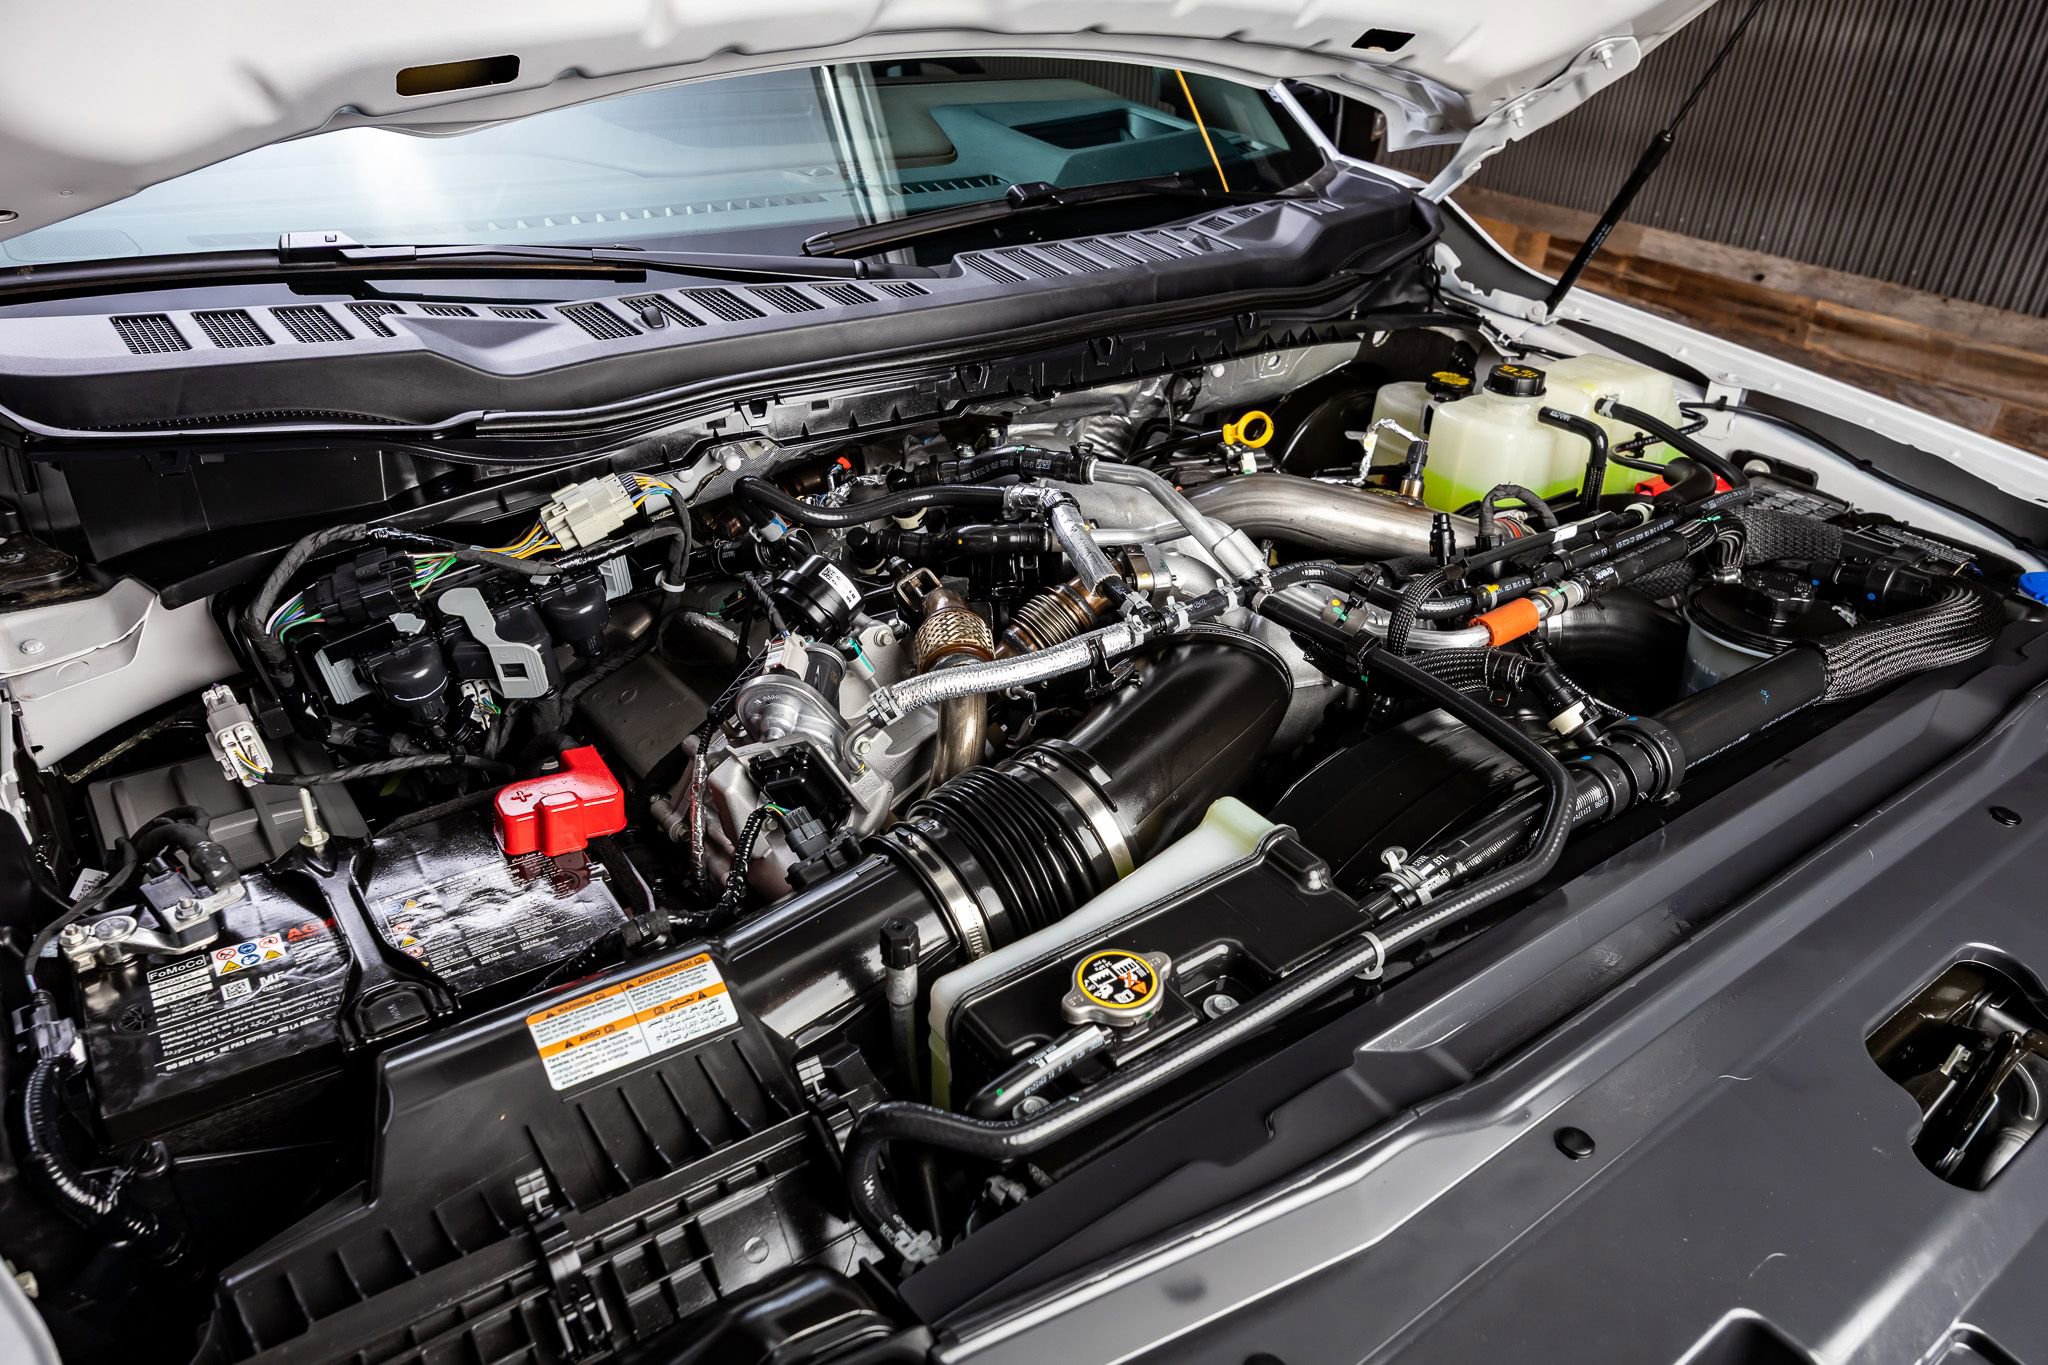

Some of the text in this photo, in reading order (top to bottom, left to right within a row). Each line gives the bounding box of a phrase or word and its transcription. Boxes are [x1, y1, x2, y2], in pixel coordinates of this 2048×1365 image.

[1432, 853, 1450, 866] BTL
[149, 959, 204, 982] FoMoCo
[259, 970, 286, 986] MF
[638, 961, 692, 984] AVERTISSEMENT
[170, 977, 206, 991] CCA/SAE
[558, 998, 592, 1012] WARNING
[669, 994, 694, 1011] تحذير
[166, 1062, 178, 1071] DO
[178, 1057, 193, 1067] NOT
[194, 1050, 216, 1062] OPEN.
[219, 1045, 229, 1053] NE
[230, 1039, 245, 1049] PAS
[245, 1030, 275, 1043] OUVRIR.
[289, 1022, 299, 1030] LA
[299, 1016, 320, 1026] ABRA.
[579, 1029, 601, 1042] AVISO
